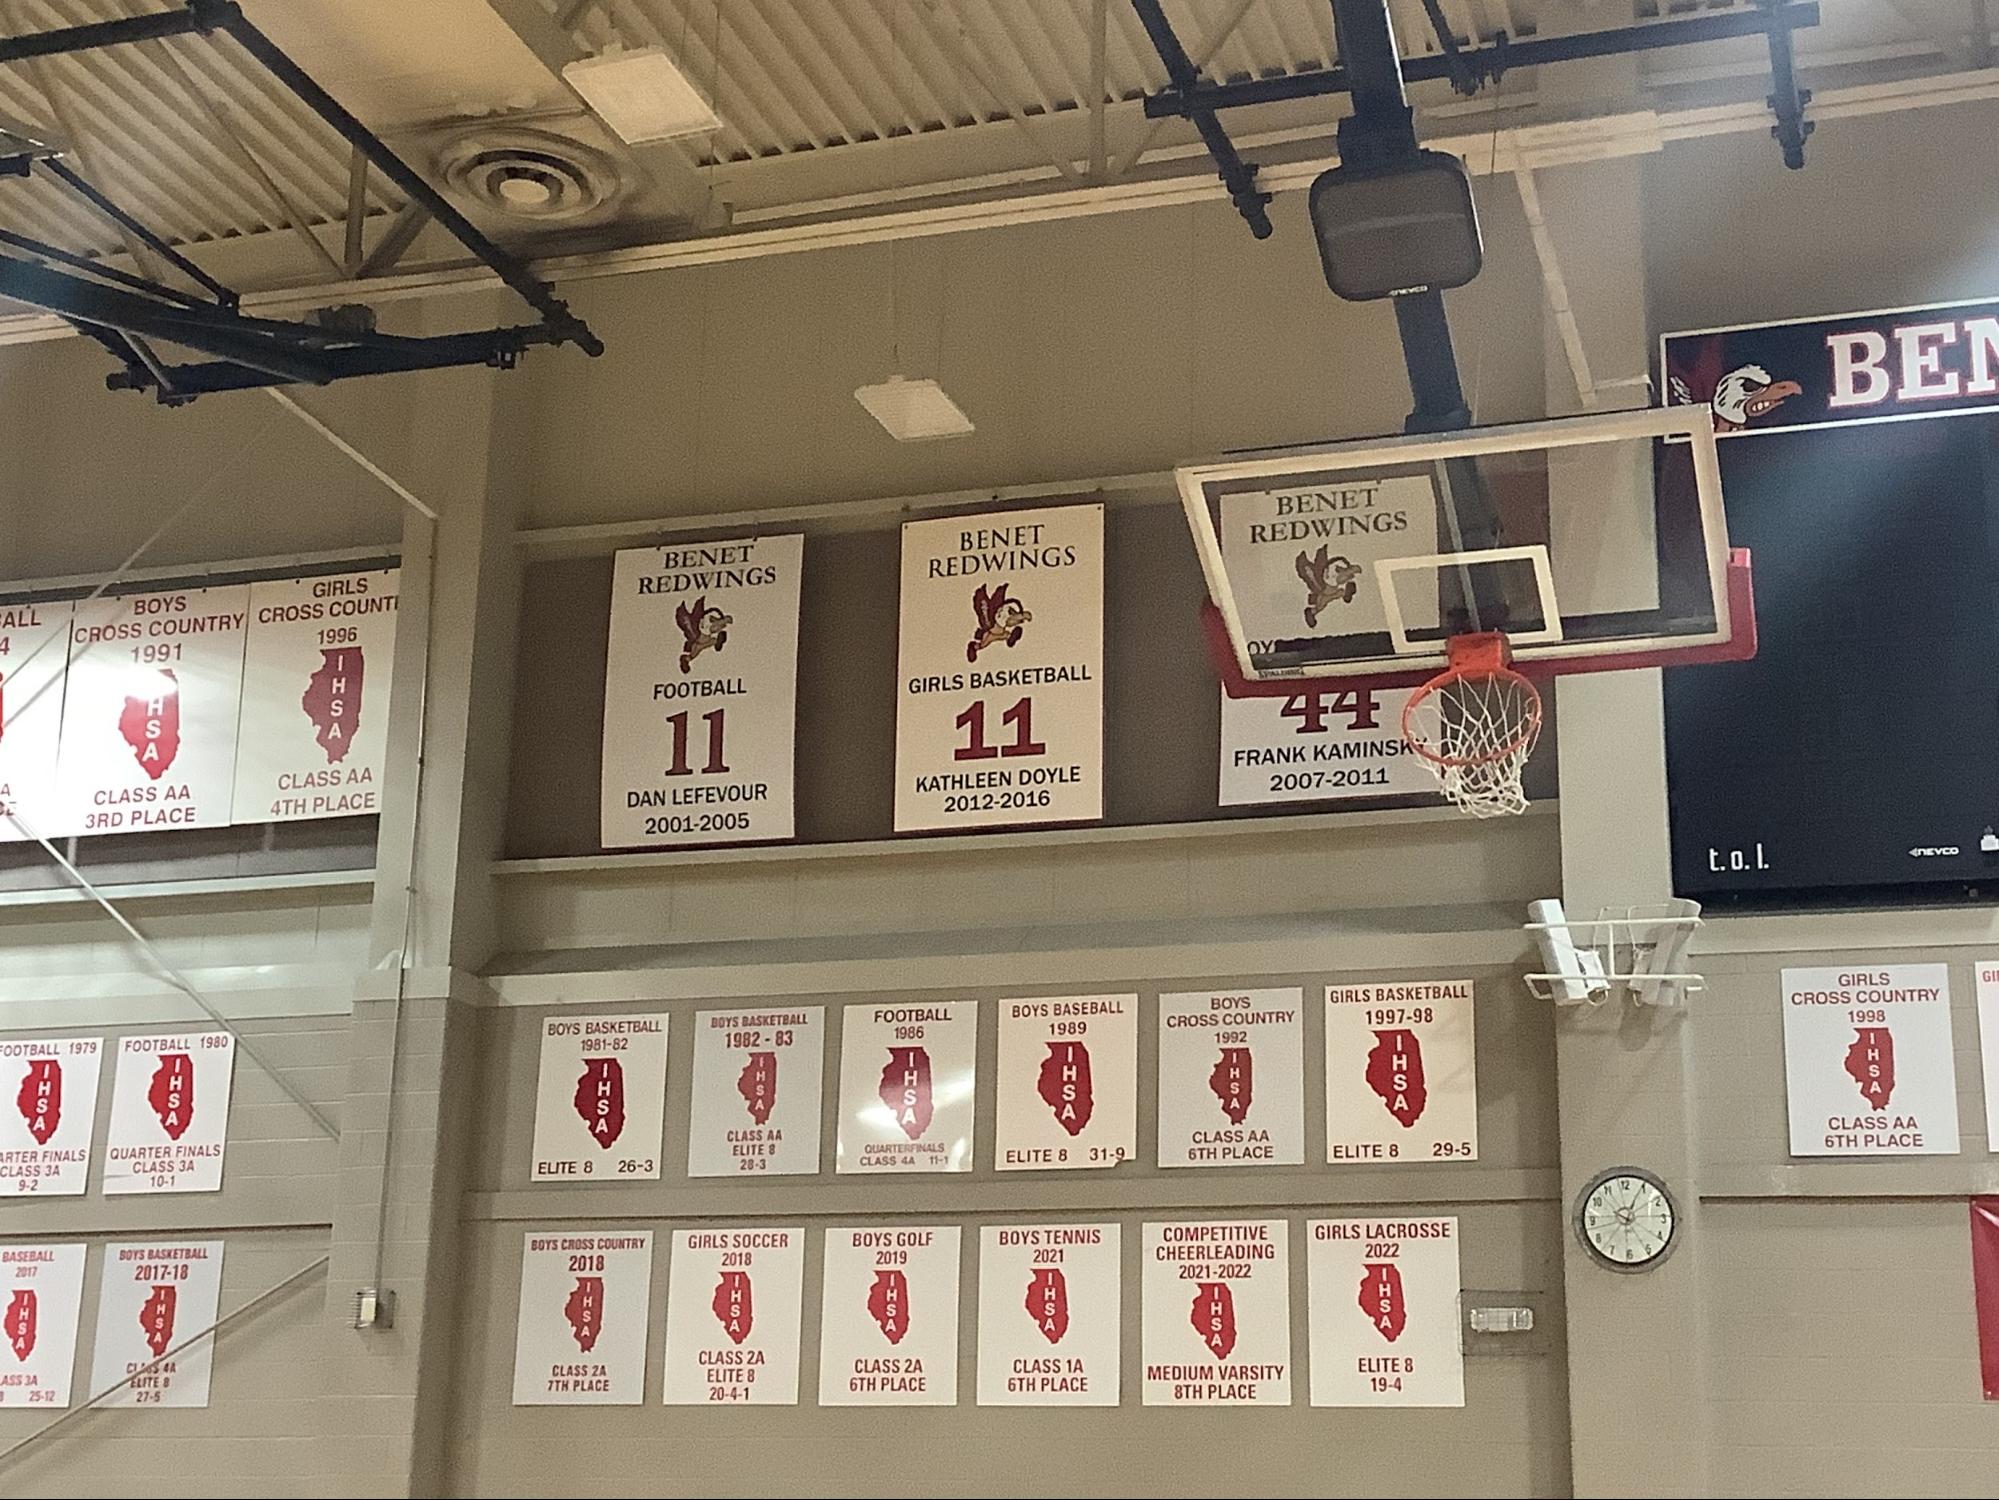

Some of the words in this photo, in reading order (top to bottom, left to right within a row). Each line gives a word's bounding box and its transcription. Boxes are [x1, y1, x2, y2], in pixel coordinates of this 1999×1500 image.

[1277, 488, 1378, 516] BENET
[1250, 511, 1408, 544] REDWINGS
[960, 525, 1045, 551] BENET
[664, 545, 754, 569] BENET
[929, 545, 1076, 578] REDWINGS
[312, 577, 368, 599] GIRLS
[638, 566, 776, 594] REDWINGS
[134, 595, 187, 615] BOYS
[258, 602, 323, 624] CROSS
[75, 620, 142, 643] CROSS
[149, 613, 244, 639] COUNTRY
[318, 627, 357, 644] 1996
[131, 643, 182, 663] 1991
[909, 675, 963, 694] GIRLS
[971, 664, 1091, 689] BASKETBALL
[653, 679, 747, 700] FOOTBALL
[1281, 687, 1380, 733] 44
[954, 697, 1046, 761] 11
[665, 708, 730, 776] 11
[1234, 747, 1306, 767] FRANK
[278, 771, 341, 790] CLASS
[347, 767, 372, 784] AA
[916, 771, 1012, 793] KATHLEEN
[1019, 766, 1080, 785] DOYLE
[1270, 767, 1390, 792] 2007-2011
[94, 787, 157, 805] CLASS
[165, 784, 190, 800] AA
[628, 789, 665, 808] DAN
[673, 784, 768, 805] LEFEVOUR
[944, 790, 1050, 812] 2012-2016
[271, 799, 307, 816] 4TH
[312, 793, 375, 812] PLACE
[86, 812, 123, 829] 3RD
[131, 807, 196, 825] PLACE
[645, 813, 749, 834] 2001-2005
[1838, 973, 1890, 986] GIRLS
[1330, 988, 1371, 1004] GIRLS
[1376, 985, 1468, 1001] BASKETBALL
[1791, 991, 1851, 1005] CROSS
[1856, 989, 1940, 1003] COUNTRY
[1012, 1004, 1049, 1019] BOYS
[1053, 1001, 1123, 1016] BASEBALL
[1211, 997, 1251, 1010] BOYS
[711, 1016, 740, 1029] BOYS
[742, 1014, 808, 1027] BASKETBALL
[874, 1009, 952, 1023] FOOTBALL
[1167, 1013, 1219, 1028] CROSS
[1223, 1011, 1295, 1026] COUNTRY
[1365, 1008, 1433, 1025] 1997-98
[1848, 1010, 1886, 1022] 1998
[548, 1023, 580, 1036] BOYS
[586, 1020, 662, 1035] BASKETBALL
[894, 1026, 924, 1040] 1986
[1049, 1021, 1087, 1036] 1989
[125, 1039, 190, 1052] FOOTBALL
[200, 1036, 228, 1048] 1980
[581, 1038, 628, 1051] 1981-82
[725, 1032, 760, 1048] 1982
[775, 1030, 793, 1047] 83
[1214, 1031, 1247, 1043] 1992
[69, 1042, 97, 1054] 1979
[1828, 1116, 1888, 1130] CLASS
[1893, 1116, 1918, 1129] AA
[727, 1130, 763, 1142] CLASS
[767, 1129, 782, 1141] AA
[1192, 1131, 1244, 1143] CLASS
[1248, 1130, 1269, 1142] AA
[1825, 1134, 1858, 1148] 6TH
[1864, 1134, 1924, 1147] PLACE
[42, 1149, 86, 1162] FINALS
[110, 1146, 171, 1160] QUARTER
[175, 1144, 221, 1158] FINALS
[733, 1144, 765, 1156] ELITE
[864, 1143, 945, 1154] QUARTERFINALS
[1006, 1149, 1052, 1163] ELITE
[1058, 1149, 1068, 1162] 8
[1089, 1147, 1125, 1162] 31-9
[1188, 1147, 1218, 1161] 6TH
[1222, 1146, 1273, 1160] PLACE
[1333, 1145, 1383, 1159] ELITE
[1389, 1144, 1399, 1157] 8
[1432, 1143, 1471, 1157] 29-5
[133, 1161, 175, 1174] CLASS
[538, 1161, 577, 1175] ELITE
[584, 1161, 593, 1174] 8
[618, 1160, 654, 1173] 26-3
[860, 1156, 897, 1166] CLASS
[18, 1180, 38, 1192] 9-2
[150, 1175, 175, 1187] 10-1
[1000, 1231, 1040, 1246] BOYS
[1044, 1229, 1101, 1244] TENNIS
[1163, 1226, 1268, 1242] COMPETITIVE
[1315, 1225, 1361, 1240] GIRLS
[1366, 1222, 1450, 1239] LACROSSE
[531, 1238, 558, 1251] BOYS
[561, 1238, 596, 1250] CROSS
[599, 1237, 645, 1249] COUNTRY
[688, 1234, 728, 1249] GIRLS
[733, 1233, 789, 1248] SOCCER
[852, 1232, 892, 1247] BOYS
[896, 1232, 934, 1246] GOLF
[2, 1251, 54, 1262] BASEBALL
[119, 1249, 145, 1261] BOYS
[148, 1248, 208, 1260] BASKETBALL
[876, 1251, 908, 1264] 2019
[1033, 1249, 1064, 1263] 2021
[1156, 1244, 1275, 1261] CHEERLEADING
[1365, 1243, 1400, 1258] 2022
[568, 1254, 605, 1272] 2018
[721, 1252, 752, 1266] 2018
[134, 1264, 188, 1281] 2017-18
[1179, 1264, 1251, 1279] 2021-2022
[698, 1350, 743, 1365] CLASS
[747, 1350, 765, 1364] 2A
[1358, 1358, 1400, 1373] ELITE
[1404, 1358, 1413, 1372] 8
[552, 1365, 589, 1377] CLASS
[591, 1365, 607, 1377] 2A
[854, 1359, 901, 1374] CLASS
[904, 1359, 923, 1373] 2A
[1013, 1359, 1060, 1374] CLASS
[1066, 1359, 1084, 1373] 1A
[1148, 1366, 1213, 1381] MEDIUM
[1218, 1365, 1284, 1380] VARSITY
[707, 1369, 743, 1383] ELITE
[747, 1369, 755, 1383] 8
[547, 1380, 570, 1392] 7TH
[573, 1379, 610, 1392] PLACE
[849, 1377, 877, 1392] 6TH
[881, 1377, 926, 1392] PLACE
[1008, 1378, 1036, 1393] 6TH
[1041, 1377, 1088, 1392] PLACE
[1174, 1384, 1203, 1400] 8TH
[1208, 1384, 1257, 1399] PLACE
[1370, 1378, 1402, 1392] 19-4
[709, 1386, 750, 1401] 20-4-1
